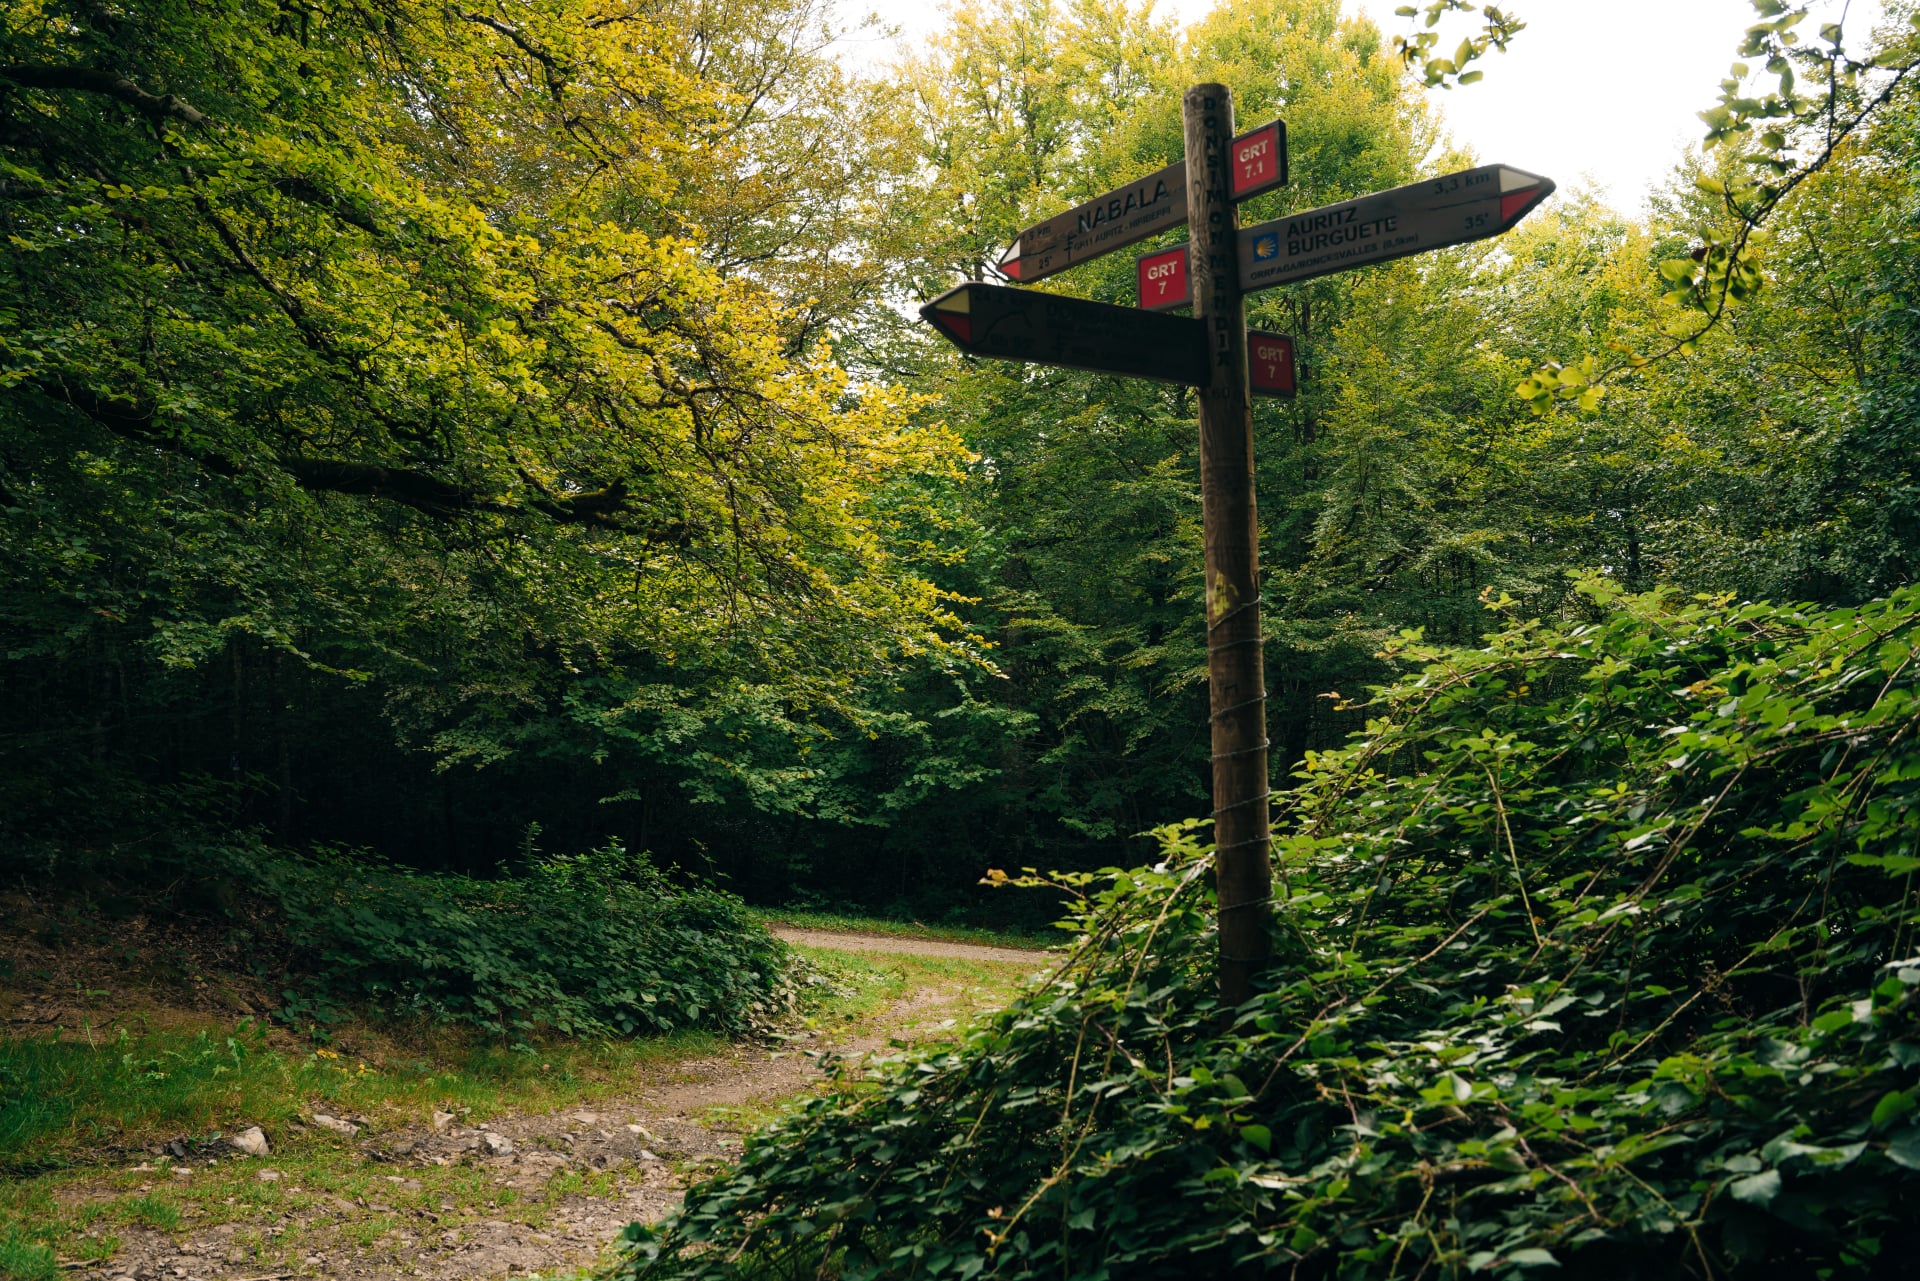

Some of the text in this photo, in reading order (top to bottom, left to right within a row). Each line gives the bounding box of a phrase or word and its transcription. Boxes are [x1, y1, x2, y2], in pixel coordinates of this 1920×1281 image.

[1239, 139, 1269, 163] GRT
[1245, 163, 1264, 179] 7.1
[1434, 172, 1491, 195] 3,3 km
[1077, 178, 1169, 234] NABALA
[1287, 205, 1359, 238] AURITZ
[1464, 212, 1489, 230] 35'
[1288, 215, 1398, 257] BURGUETE
[1147, 260, 1178, 281] GRT
[1158, 281, 1168, 296] 7
[1257, 345, 1285, 362] GRT
[1267, 365, 1276, 379] 7
